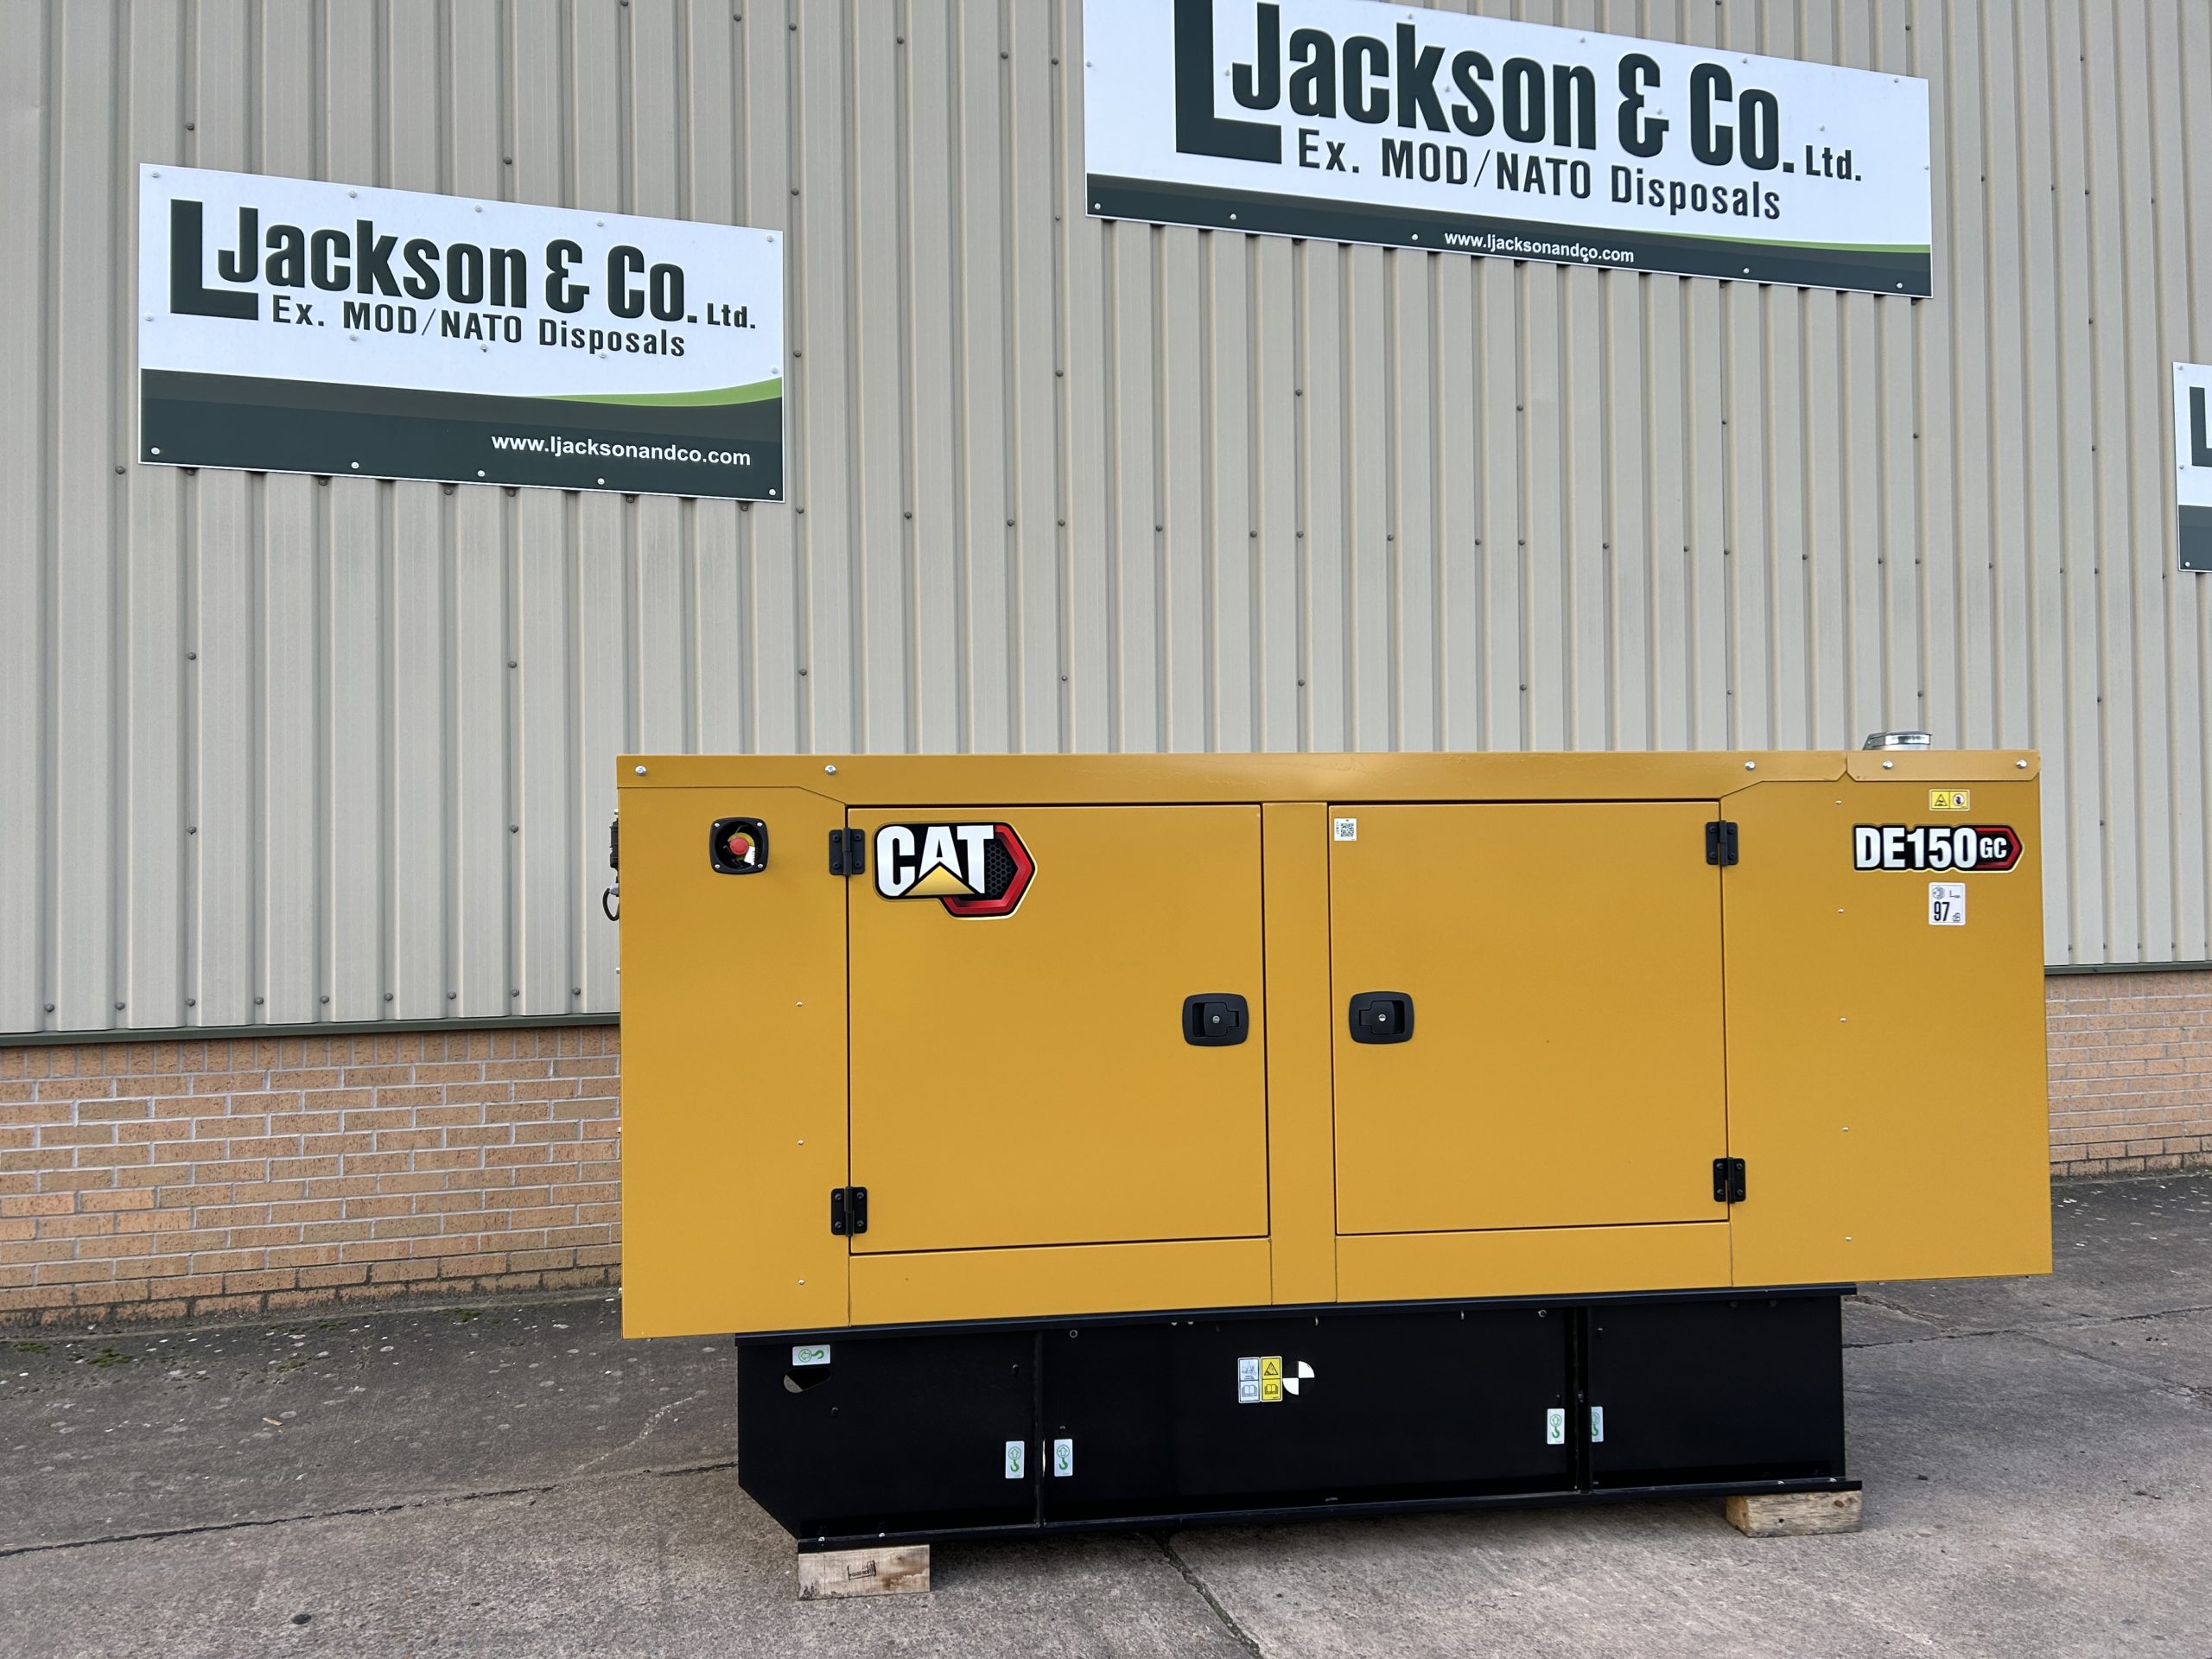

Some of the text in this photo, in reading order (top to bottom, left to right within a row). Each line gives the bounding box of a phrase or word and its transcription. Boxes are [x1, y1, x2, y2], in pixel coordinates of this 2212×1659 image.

[1618, 53, 1669, 157] &
[1690, 62, 1795, 173] Co.
[1805, 145, 1861, 181] Ltd.
[1299, 128, 1781, 219] Ex. MOD/NATO Disposals
[1444, 232, 1635, 263] www.ljacksonandco.com
[545, 238, 590, 313] &
[607, 245, 697, 323] Co.
[707, 302, 756, 329] Ltd.
[273, 294, 685, 357] Ex. MOD/NATO Disposals
[491, 435, 751, 466] www.ljacksonandco.com
[876, 825, 995, 897] CAT
[1934, 901, 1950, 922] 97
